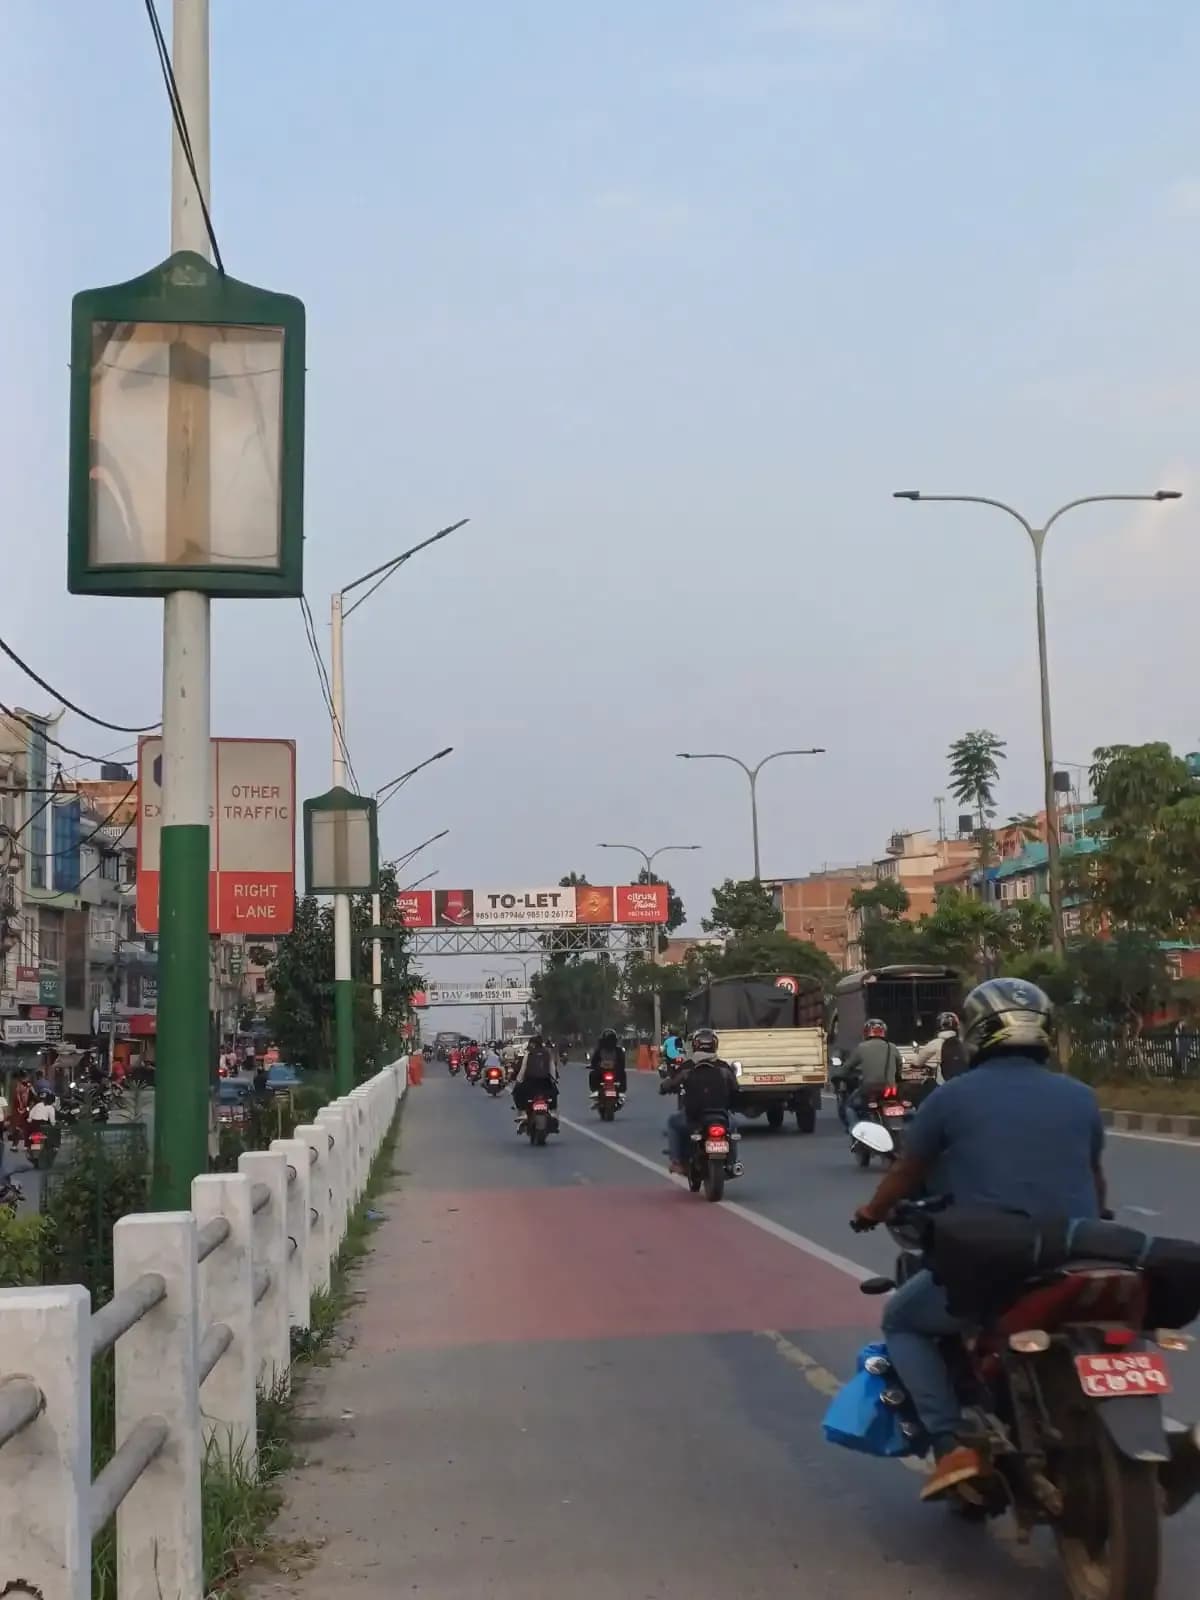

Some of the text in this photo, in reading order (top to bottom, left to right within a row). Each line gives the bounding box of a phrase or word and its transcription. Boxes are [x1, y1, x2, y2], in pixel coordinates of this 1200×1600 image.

[231, 785, 280, 799] OTHER
[224, 806, 289, 820] TRAFFIC
[233, 884, 279, 898] RIGHT
[487, 893, 562, 909] TO-LET
[236, 905, 276, 919] LANE
[551, 910, 574, 919] 26172
[441, 991, 463, 1000] DAV
